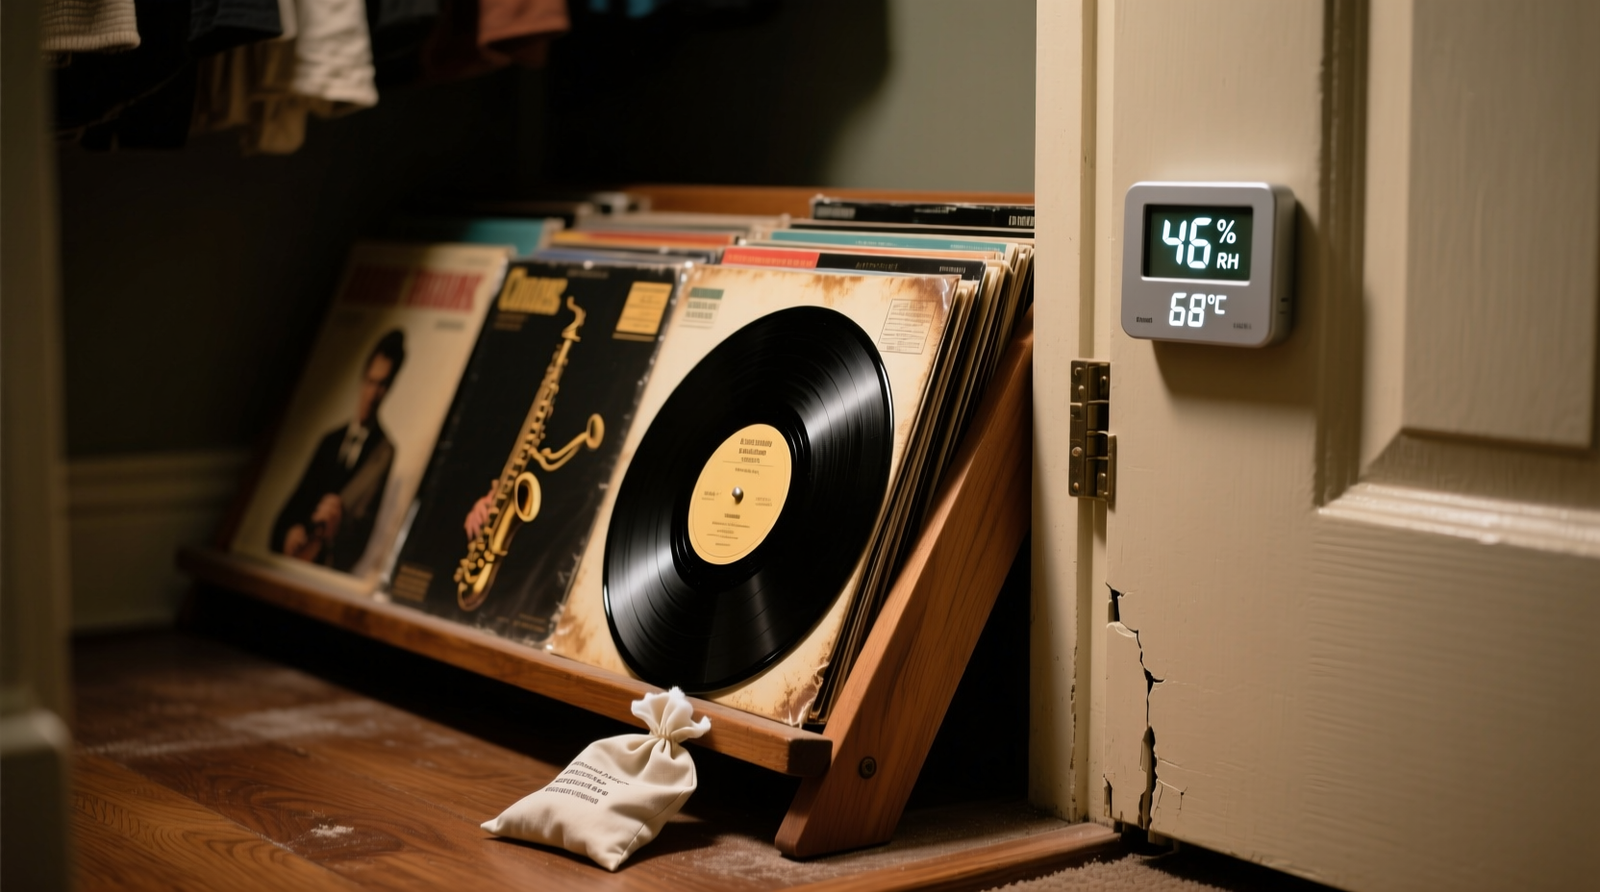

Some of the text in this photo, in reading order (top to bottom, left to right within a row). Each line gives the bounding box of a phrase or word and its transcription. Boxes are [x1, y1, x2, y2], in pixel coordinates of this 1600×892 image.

[1162, 217, 1237, 269] 46 %
[1216, 252, 1240, 270] RH
[1168, 292, 1228, 328] 68°C
